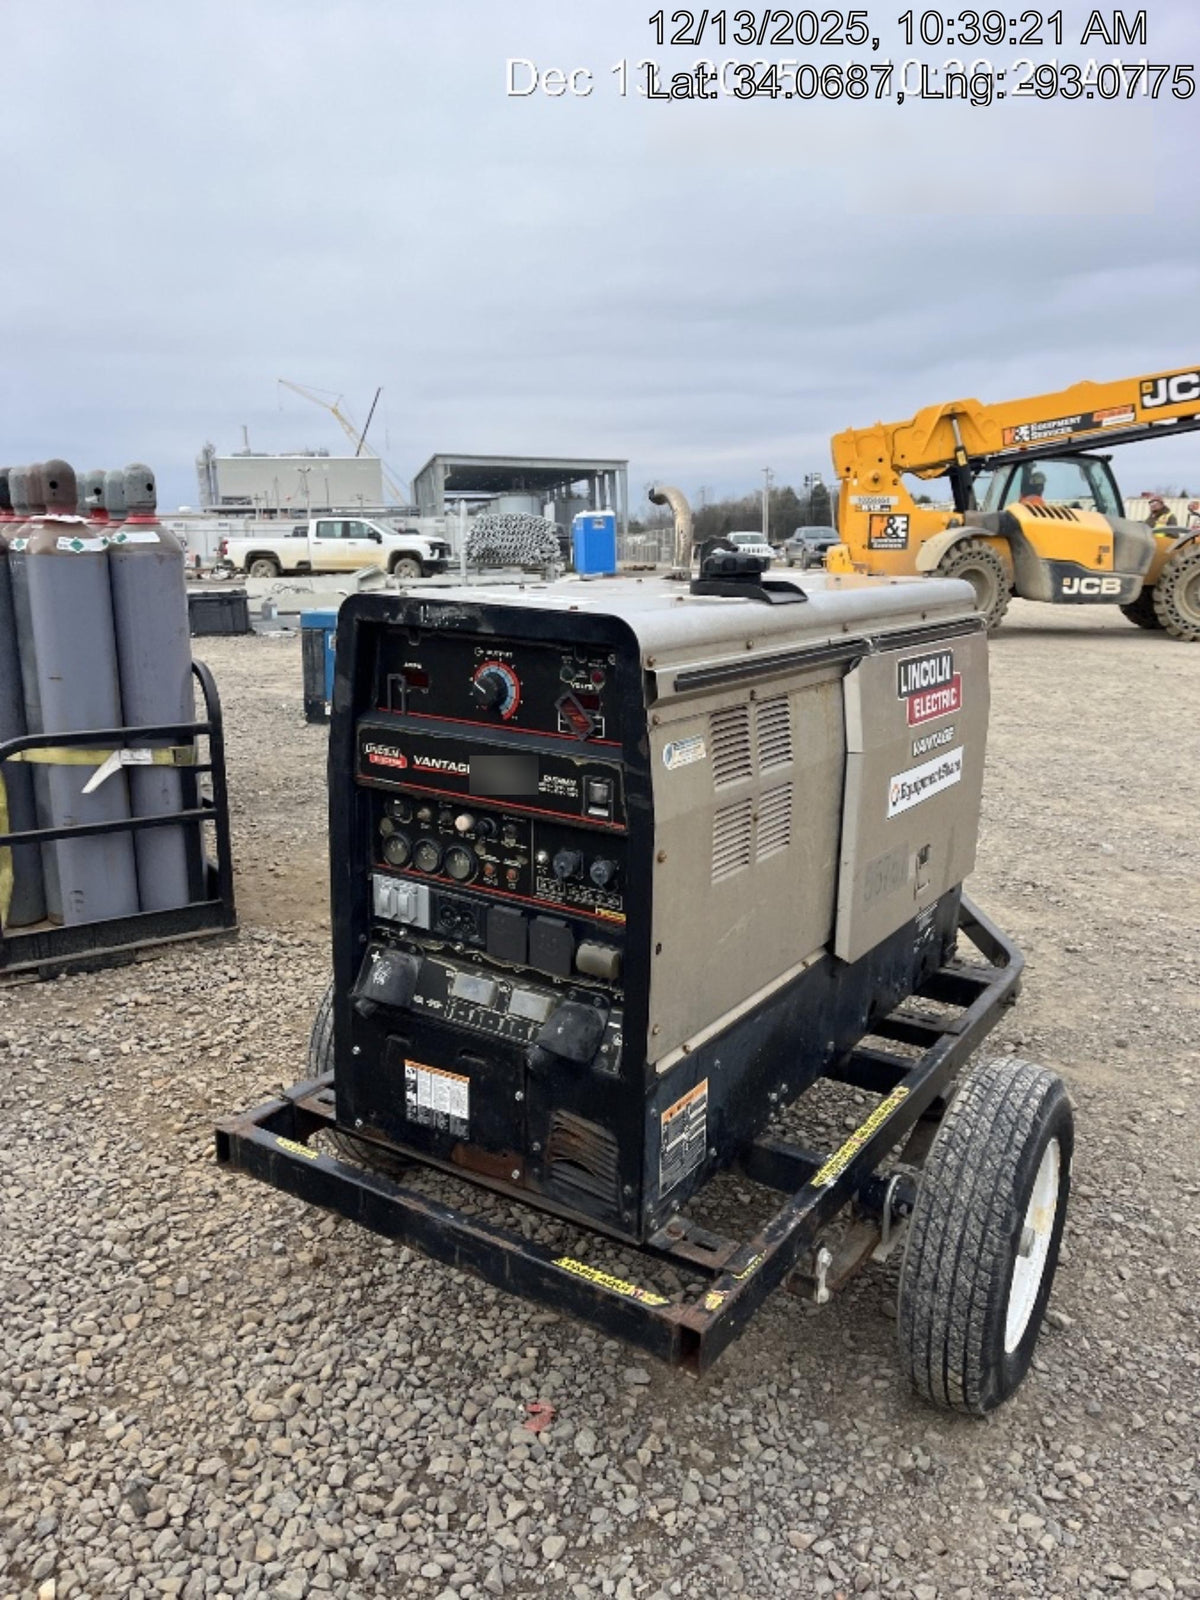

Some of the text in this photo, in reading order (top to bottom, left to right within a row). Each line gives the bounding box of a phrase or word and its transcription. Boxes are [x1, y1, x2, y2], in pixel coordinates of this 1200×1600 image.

[1062, 576, 1122, 595] JCB
[900, 654, 951, 694] LINCOLN
[913, 686, 958, 720] ELECTRIC
